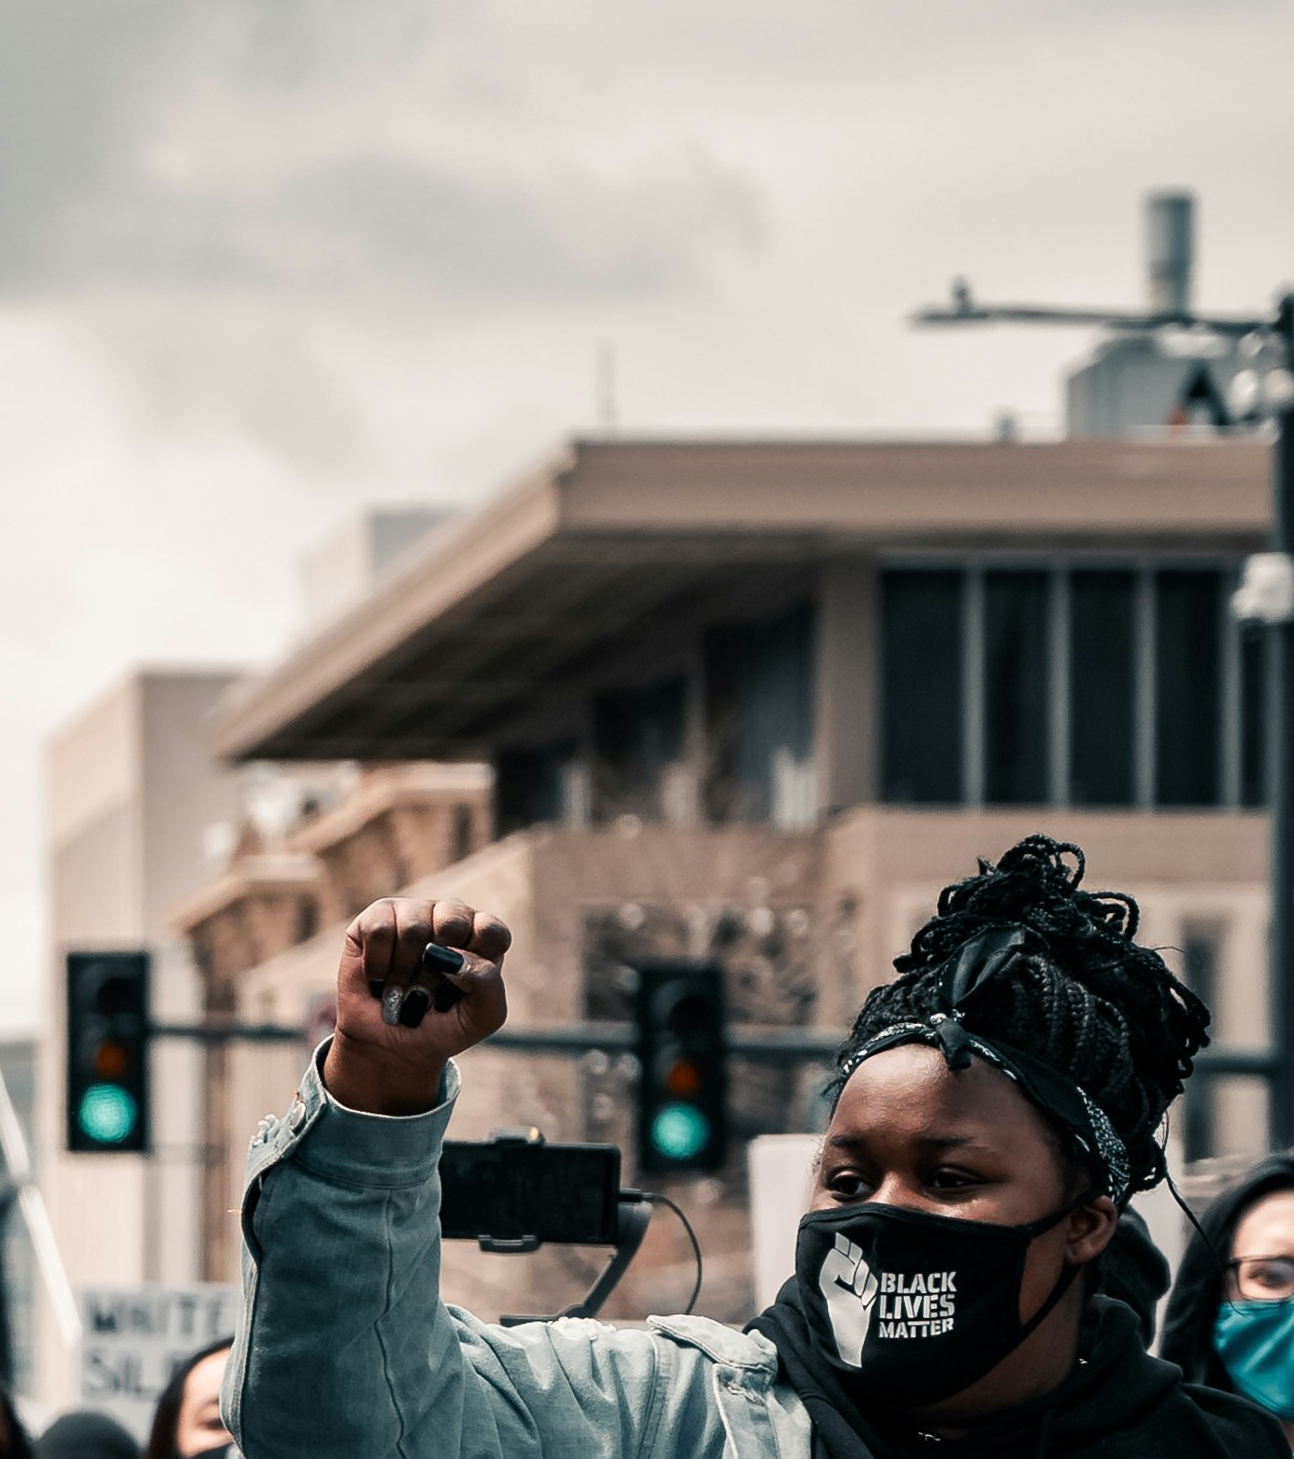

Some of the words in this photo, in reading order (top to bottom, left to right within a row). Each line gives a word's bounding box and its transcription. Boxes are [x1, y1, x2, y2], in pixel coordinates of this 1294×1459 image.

[880, 1271, 958, 1294] BLACK
[879, 1293, 956, 1320] LIVES
[878, 1317, 955, 1339] MATTER
